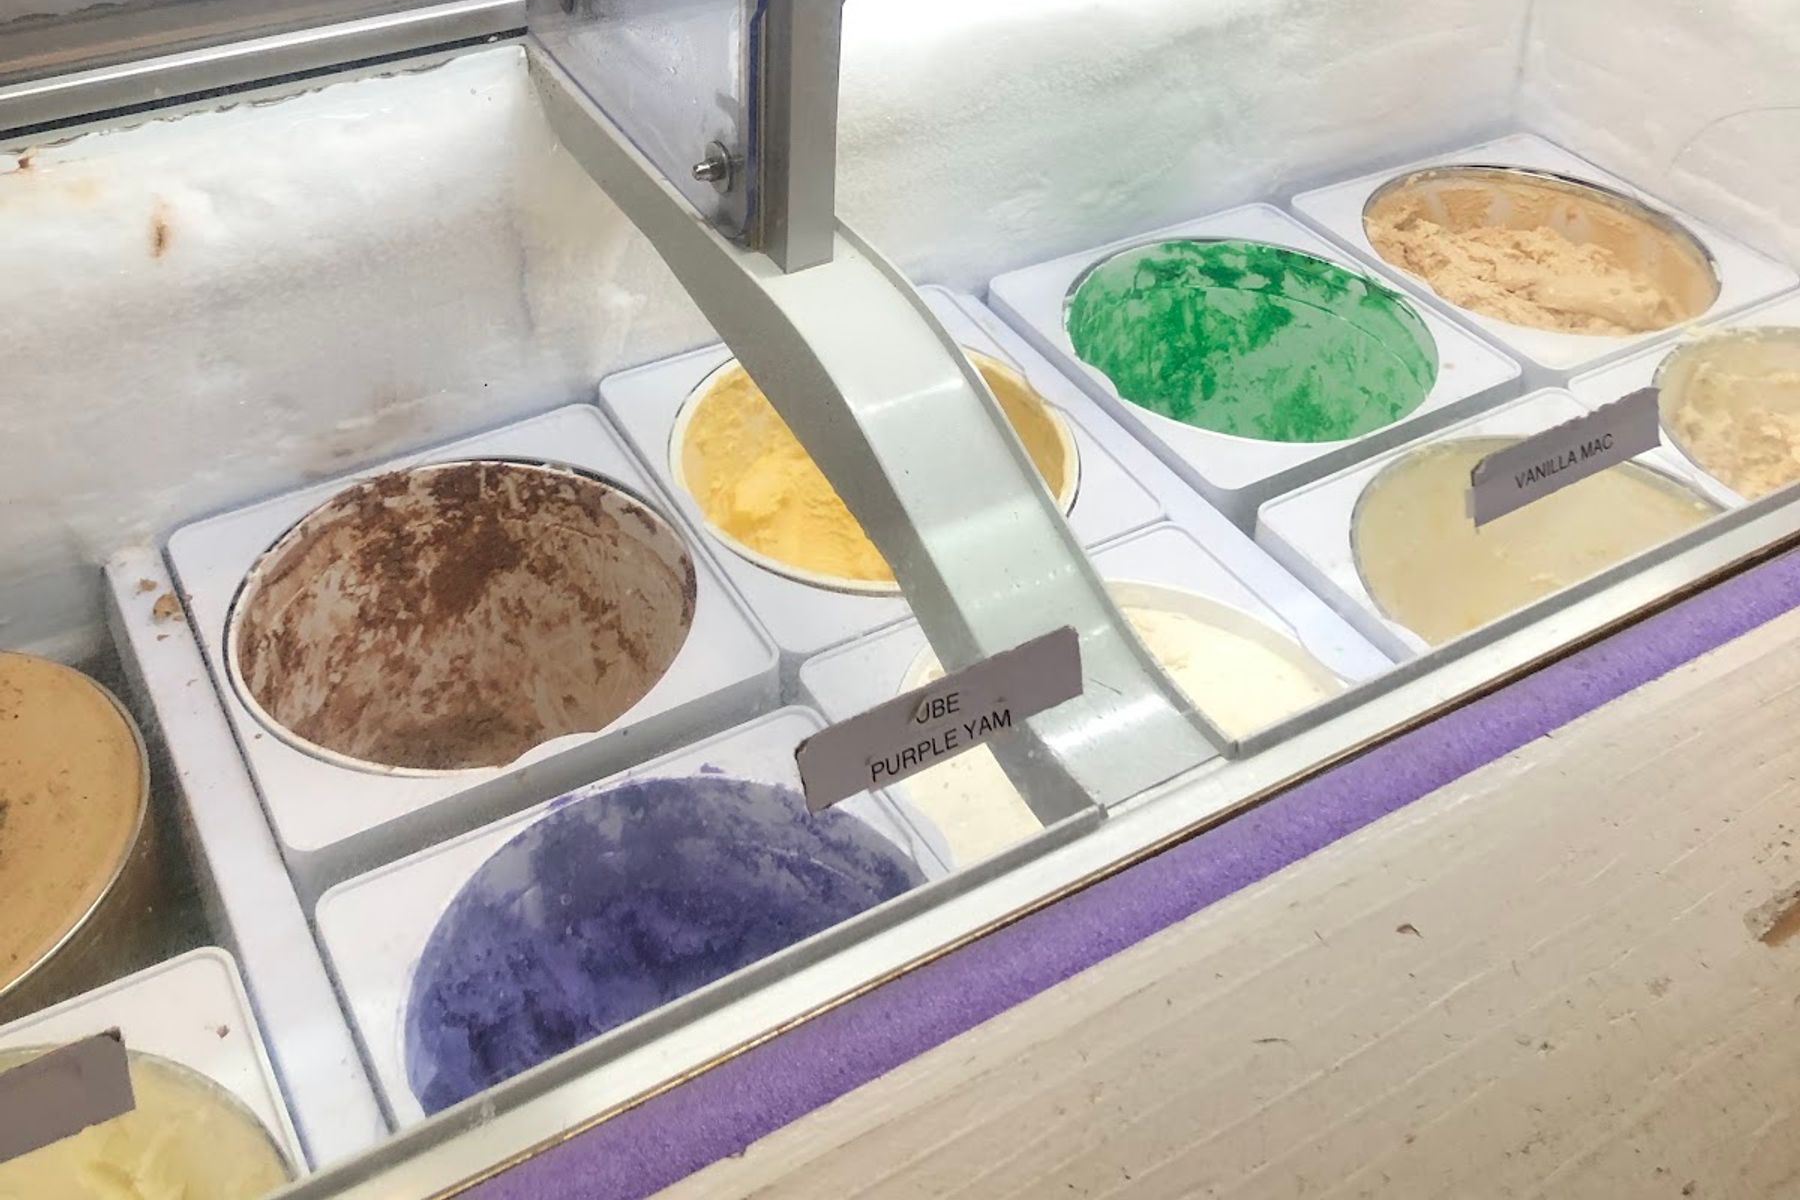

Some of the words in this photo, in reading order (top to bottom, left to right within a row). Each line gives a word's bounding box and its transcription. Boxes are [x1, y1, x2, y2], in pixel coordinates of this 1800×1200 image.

[1514, 450, 1578, 489] VANILLA
[1580, 433, 1614, 461] MAC
[870, 728, 959, 783] PURPLE
[963, 708, 1013, 740] YAM
